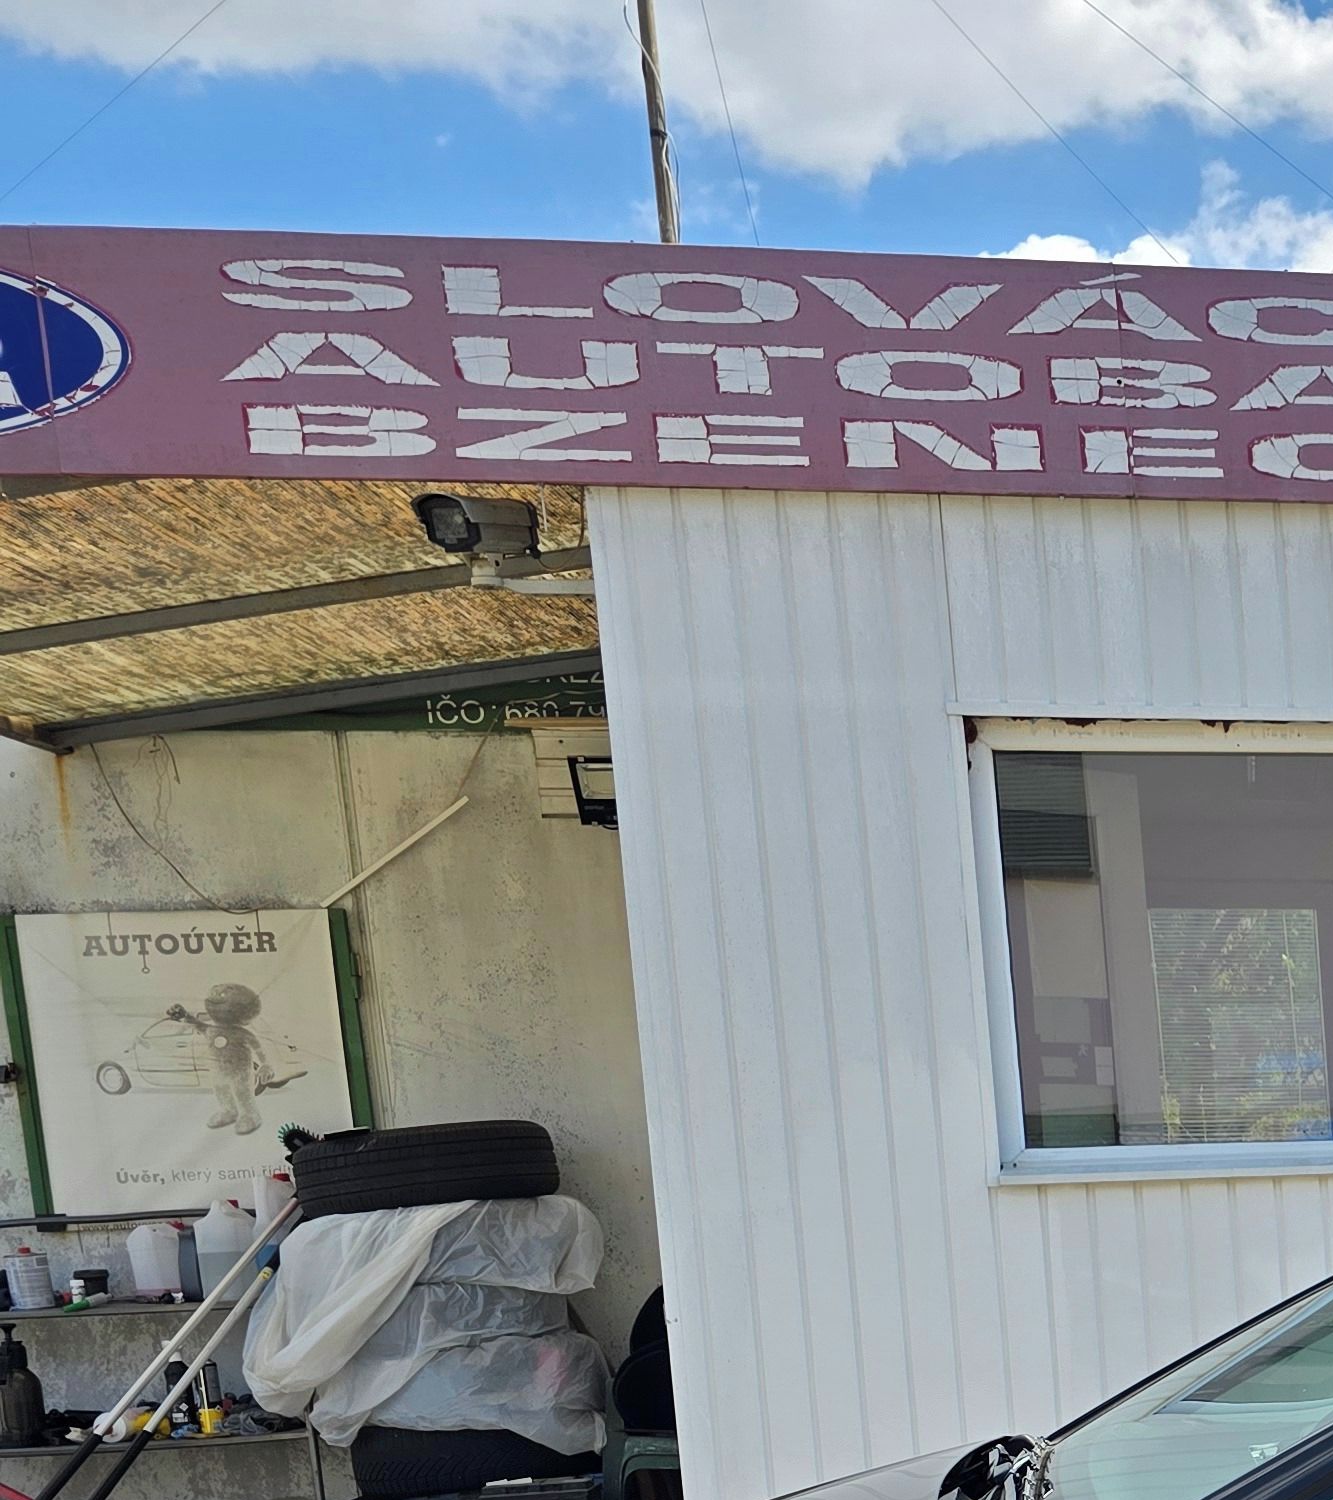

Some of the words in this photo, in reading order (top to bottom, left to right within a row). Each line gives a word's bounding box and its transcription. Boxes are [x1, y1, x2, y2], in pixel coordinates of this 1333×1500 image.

[83, 925, 278, 957] AUTOÚVĚR
[116, 1167, 165, 1184] Úvěr,
[172, 1167, 212, 1183] který
[218, 1167, 256, 1181] sami
